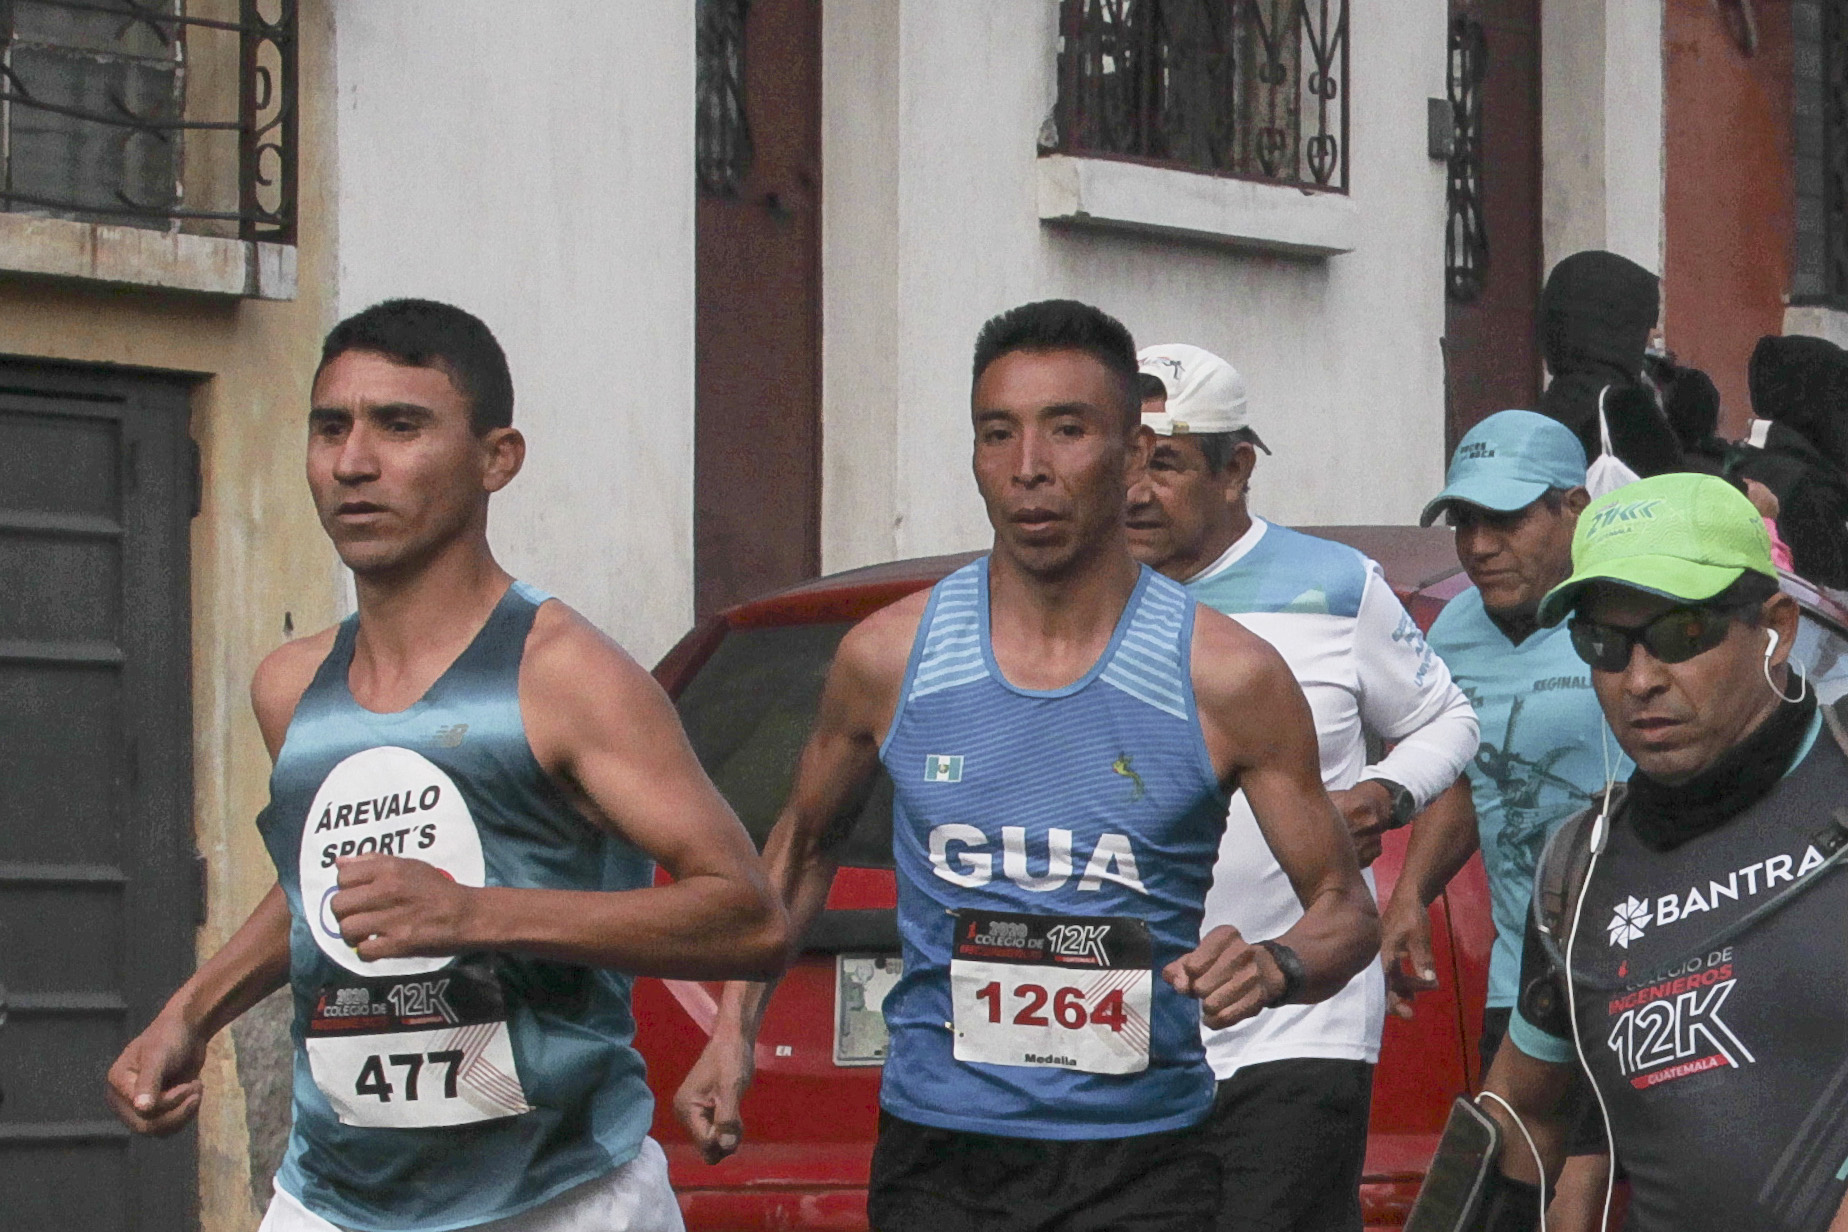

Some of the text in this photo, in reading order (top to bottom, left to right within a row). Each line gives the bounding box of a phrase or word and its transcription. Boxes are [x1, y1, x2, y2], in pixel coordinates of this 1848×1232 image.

[315, 785, 441, 834] ÁREVALO
[928, 823, 1149, 895] GUA
[1047, 924, 1111, 967] 12K
[1707, 946, 1734, 968] DE
[387, 978, 460, 1025] 12K
[975, 981, 1128, 1033] 1264
[1607, 979, 1756, 1077] 12K
[354, 1049, 465, 1103] 477
[1025, 1053, 1077, 1066] Medalla
[1648, 1058, 1719, 1085] GUATEMALA
